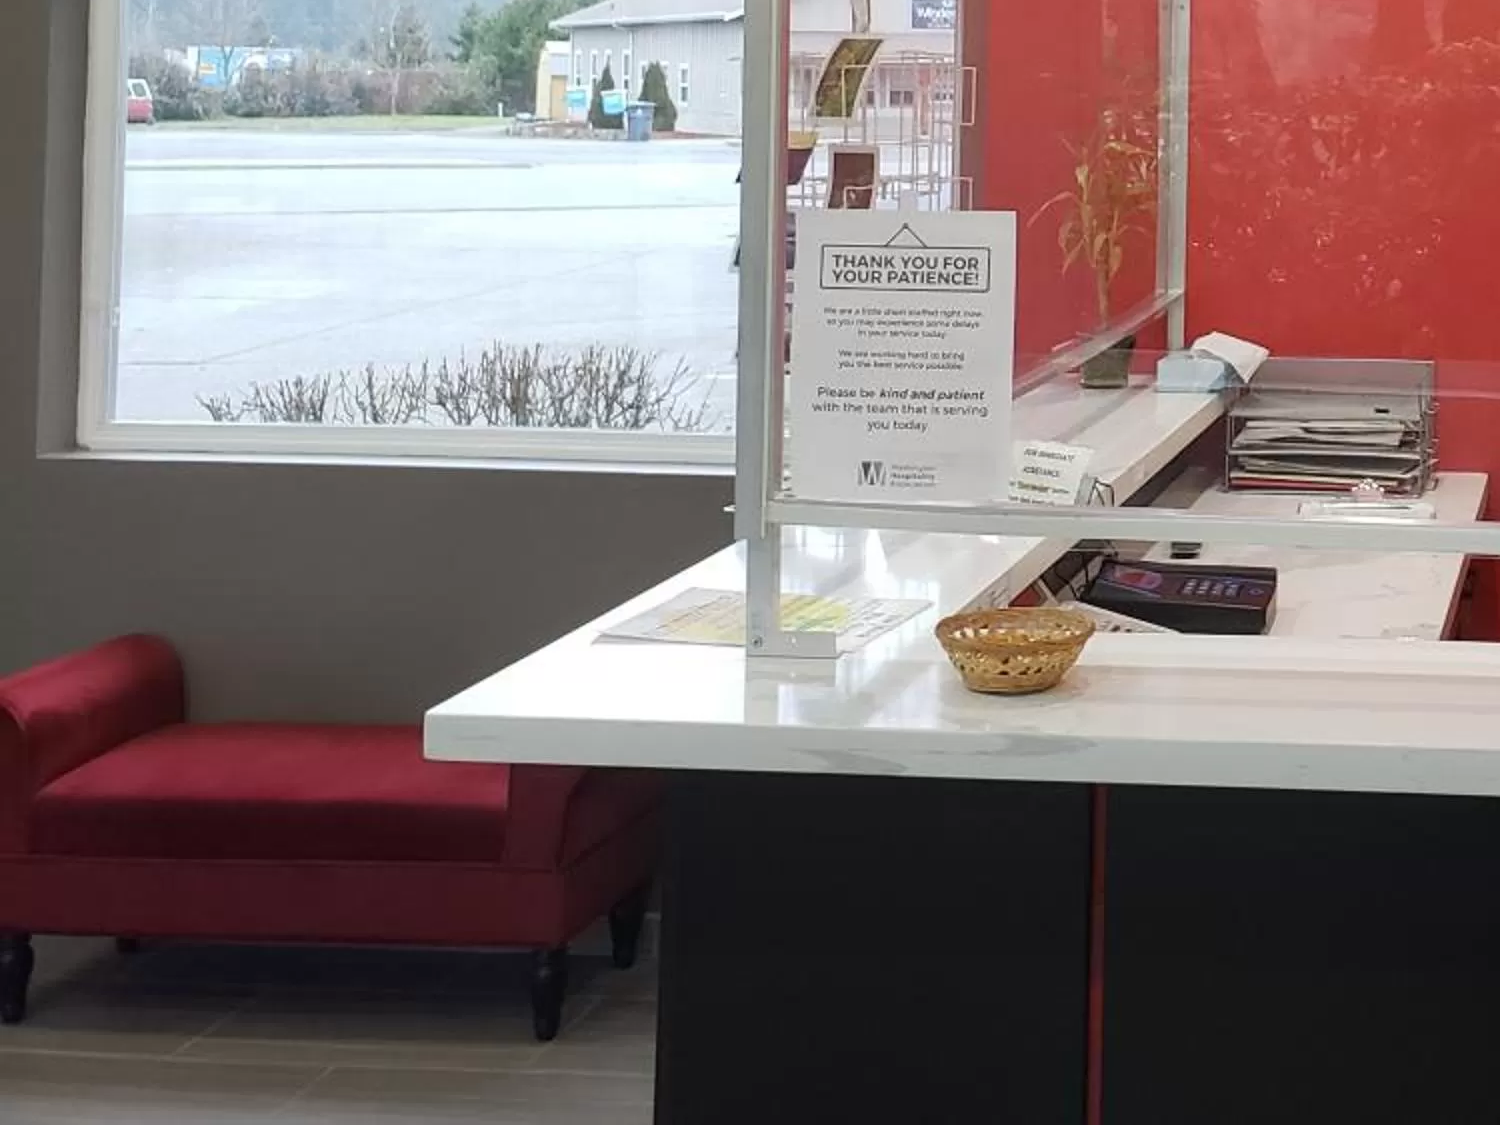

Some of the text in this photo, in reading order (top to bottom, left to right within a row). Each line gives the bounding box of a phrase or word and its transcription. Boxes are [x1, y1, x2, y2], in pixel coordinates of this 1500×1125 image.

[832, 254, 979, 270] THANK YOU FOR
[831, 269, 980, 286] YOUR PATIENCE!
[838, 319, 854, 328] you
[838, 360, 854, 369] you
[817, 386, 985, 402] Please be kind and patient
[812, 401, 989, 418] with the team that is serving
[867, 421, 890, 432] you
